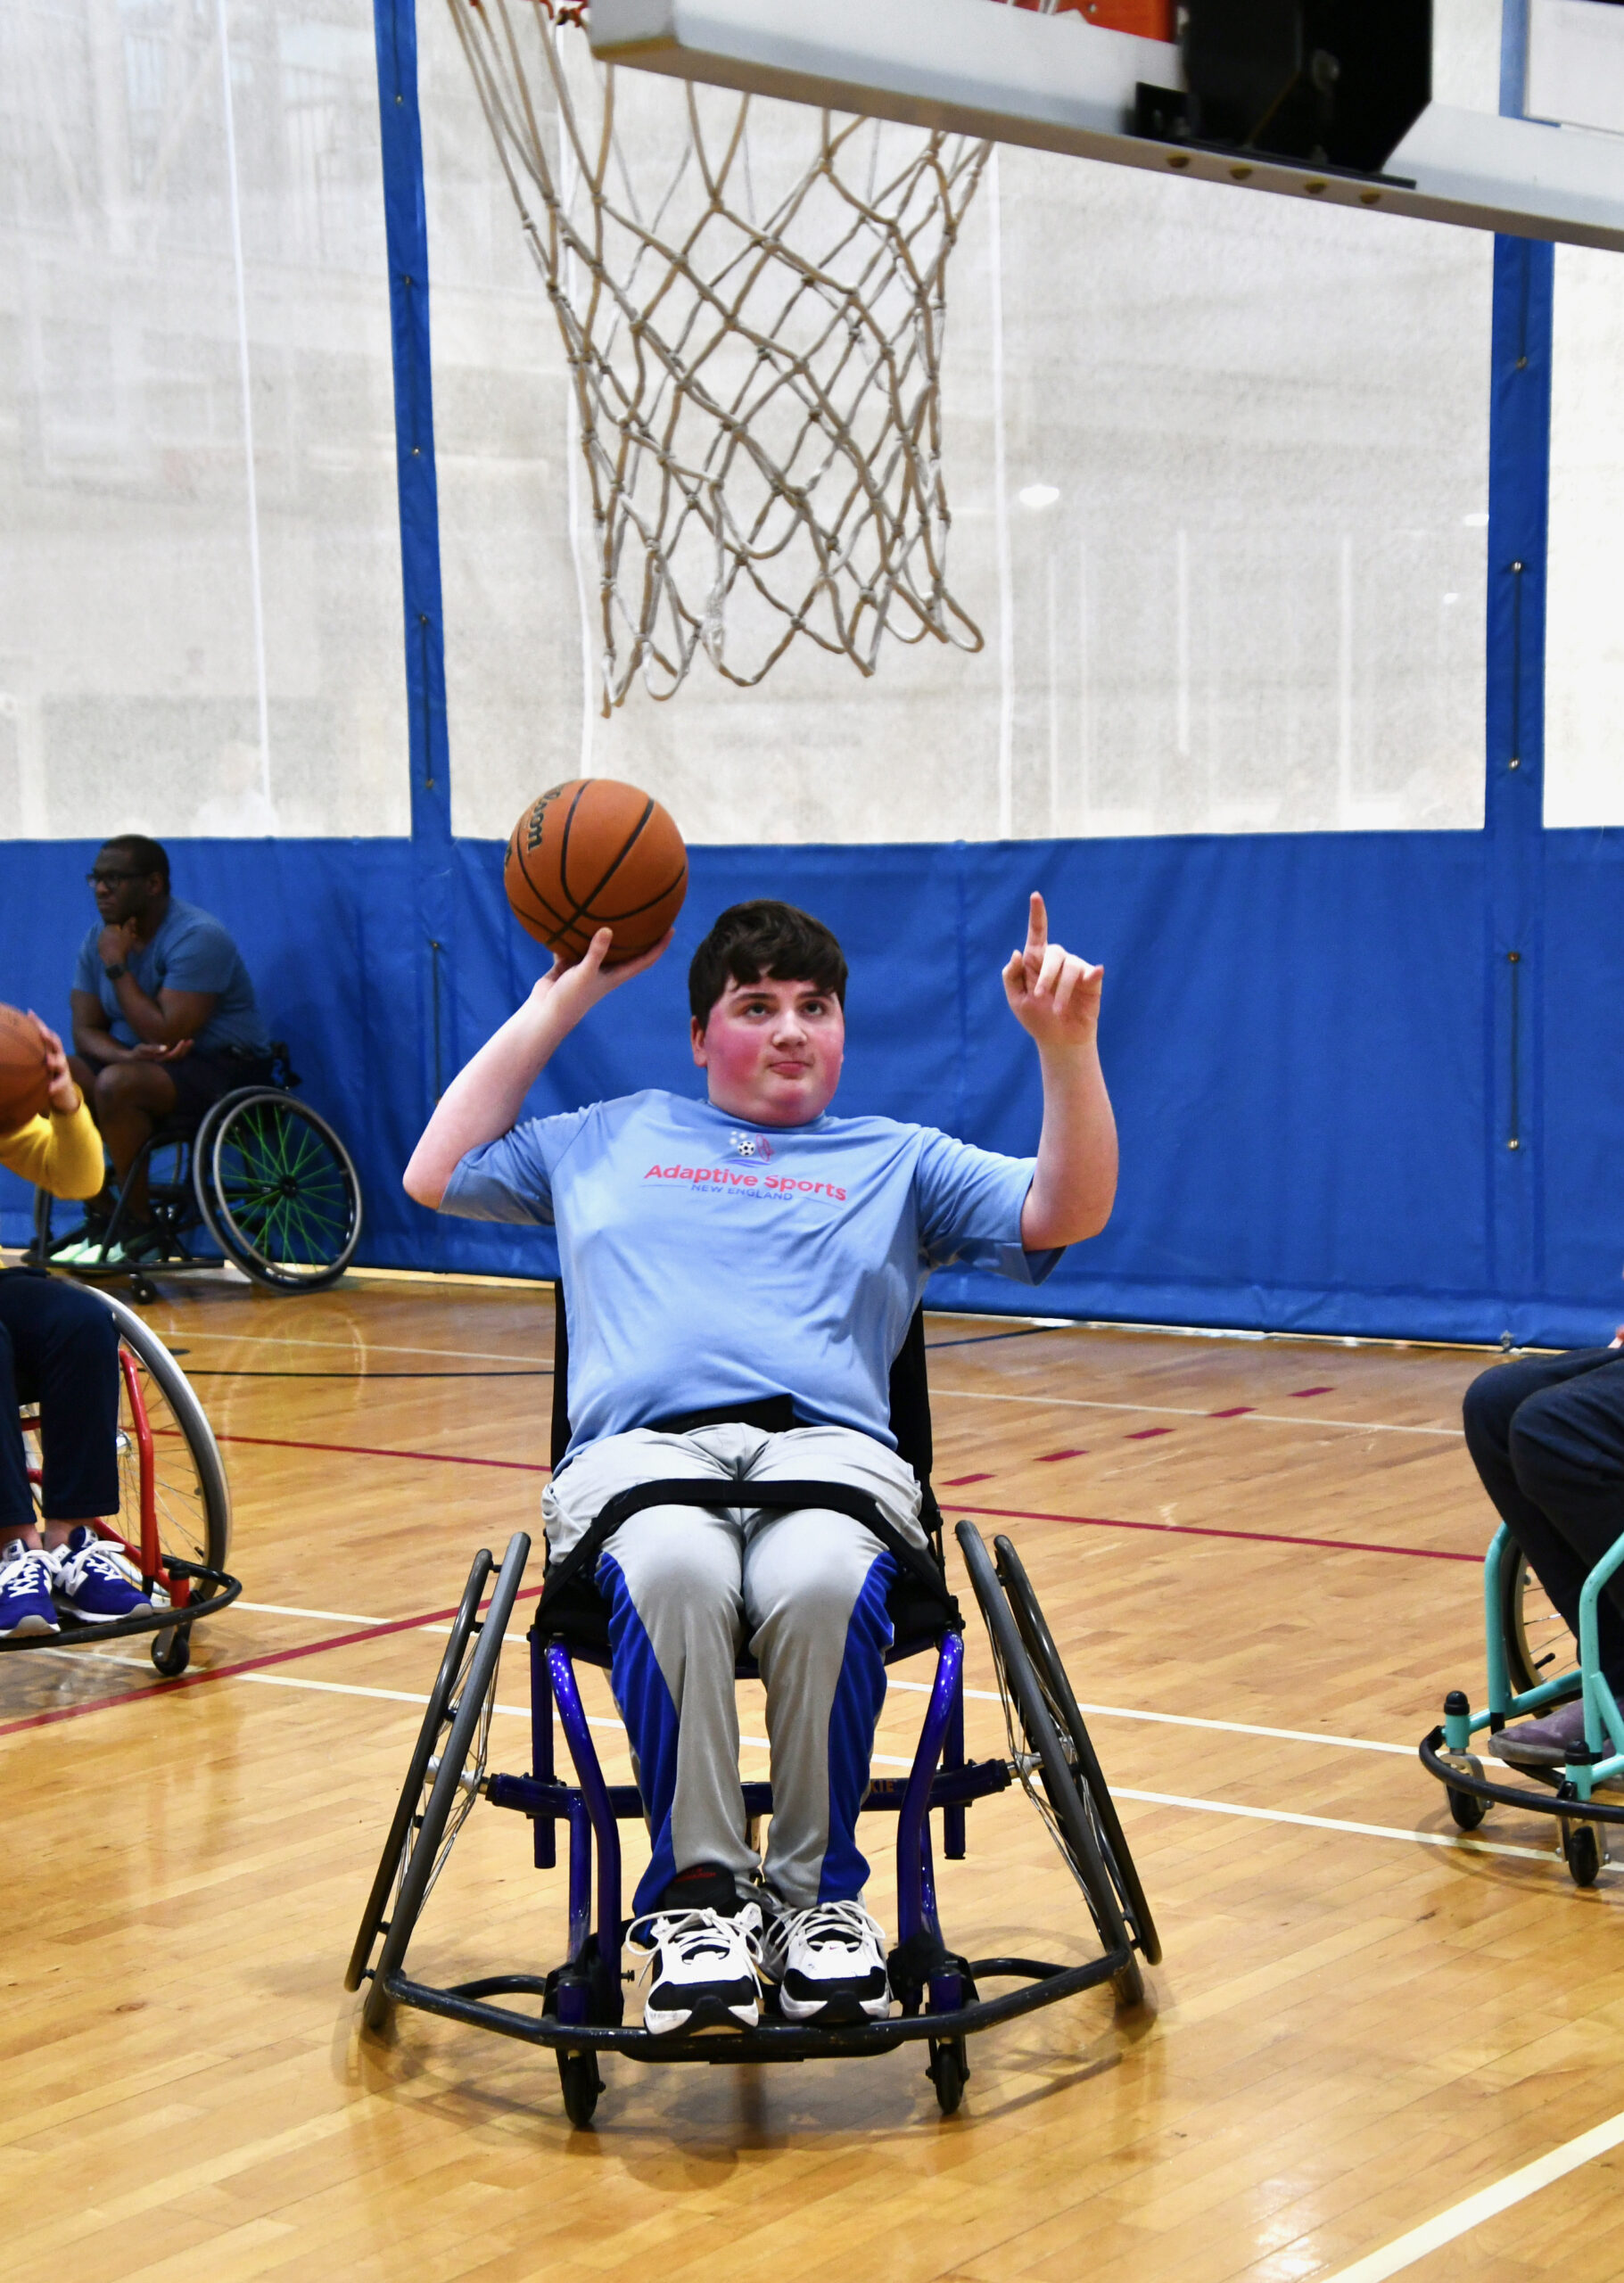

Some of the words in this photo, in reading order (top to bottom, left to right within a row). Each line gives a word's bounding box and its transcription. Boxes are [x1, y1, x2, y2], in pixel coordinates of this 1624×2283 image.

[644, 1164, 758, 1187] Adaptive
[764, 1174, 847, 1202] Sports
[690, 1183, 724, 1194] NEW
[728, 1187, 793, 1201] ENGLAND
